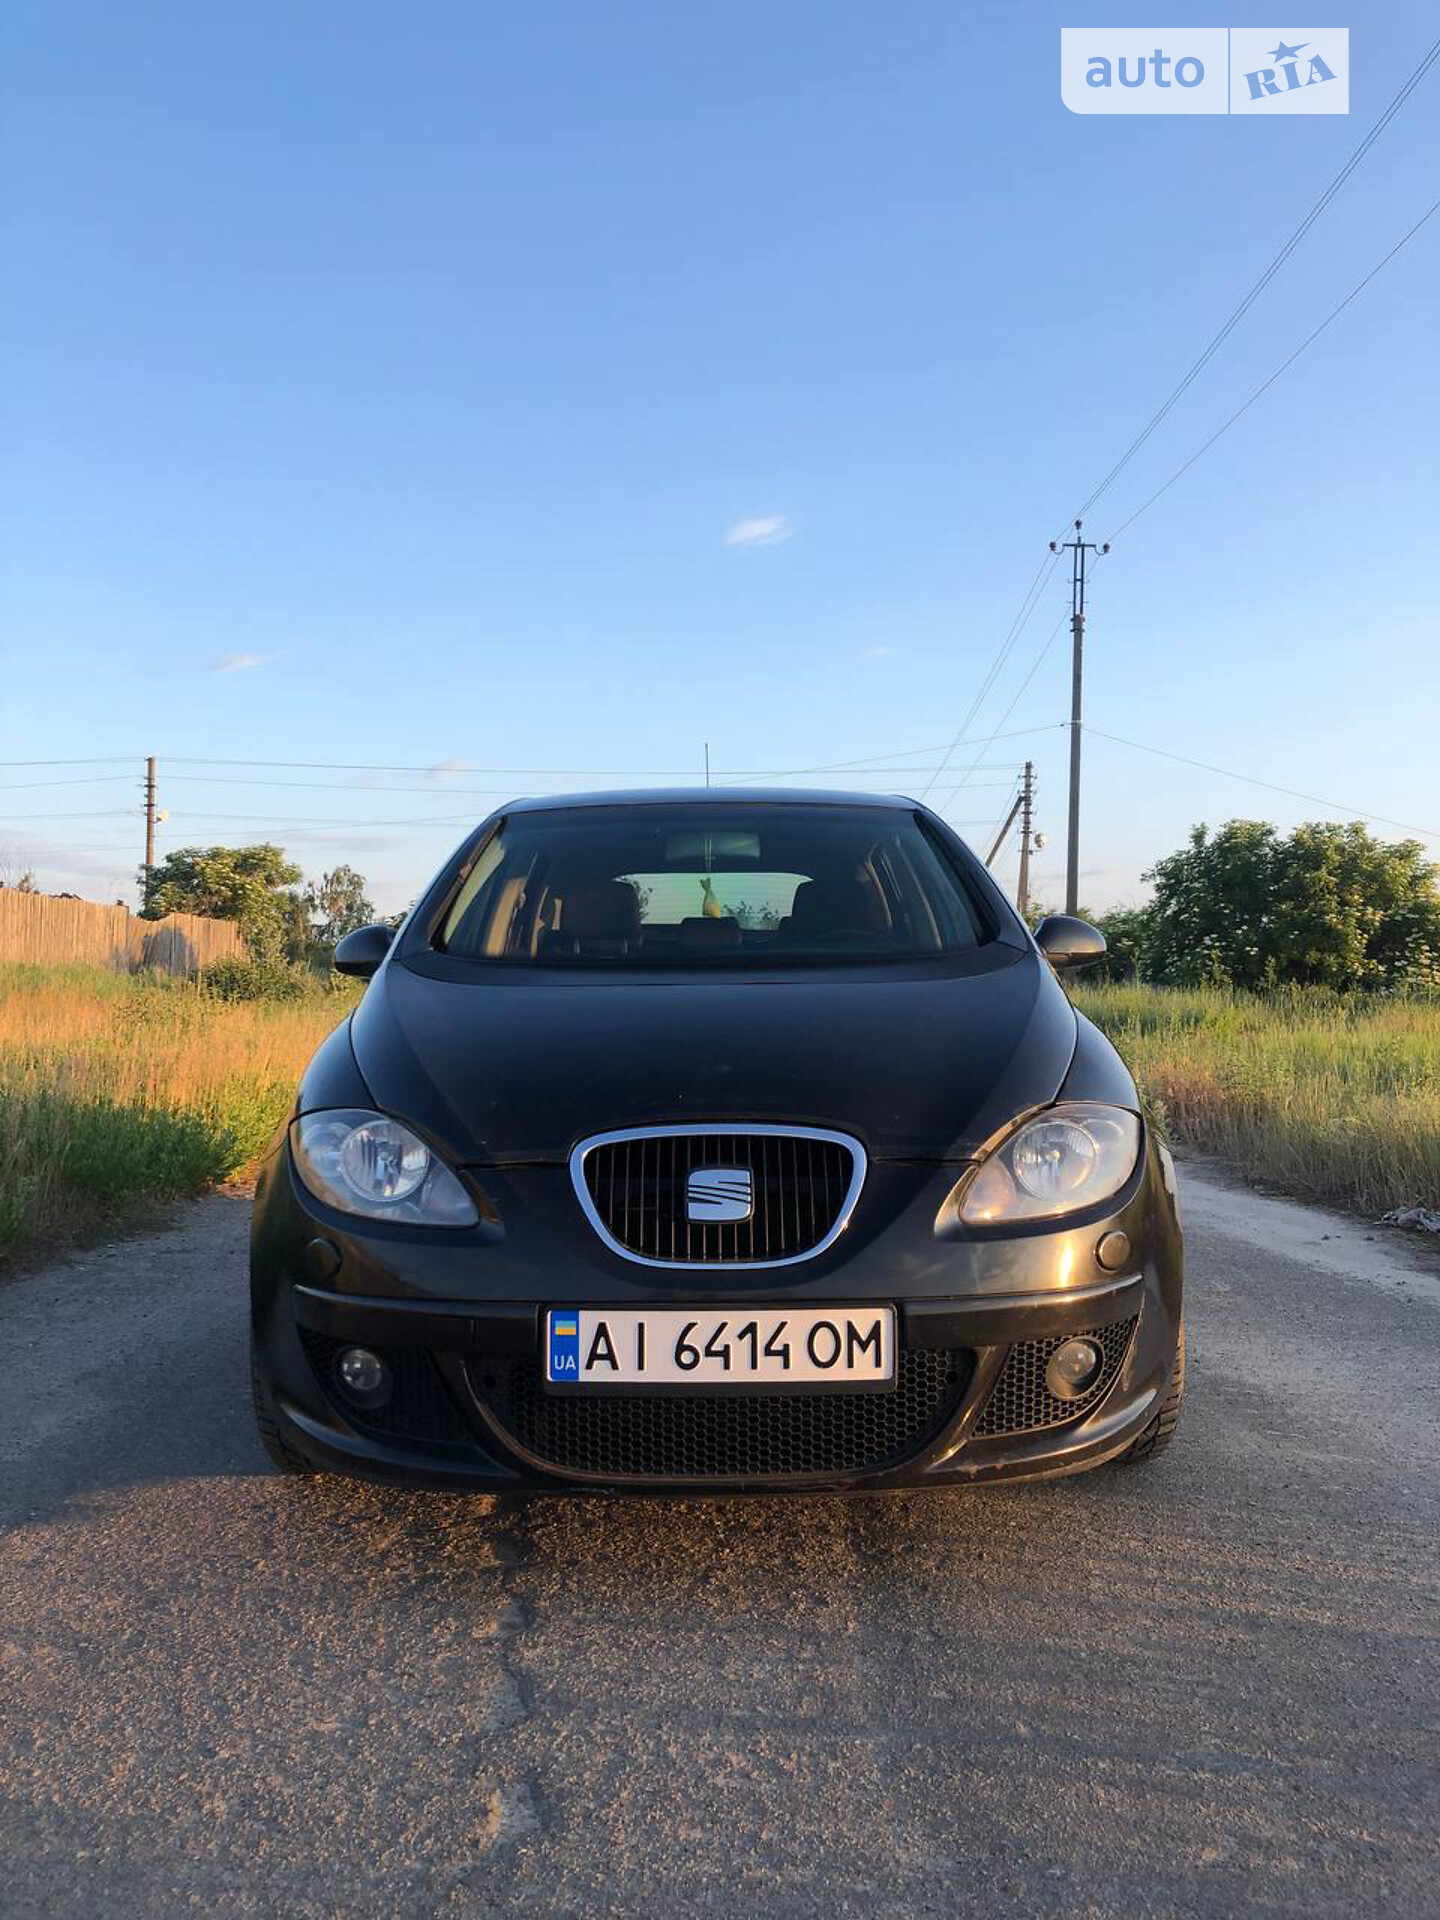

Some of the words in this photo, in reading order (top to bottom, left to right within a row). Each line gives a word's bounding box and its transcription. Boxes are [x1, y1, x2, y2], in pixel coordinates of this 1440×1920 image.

[674, 1320, 791, 1371] 6414
[807, 1319, 882, 1370] OM
[554, 1354, 577, 1371] UA
